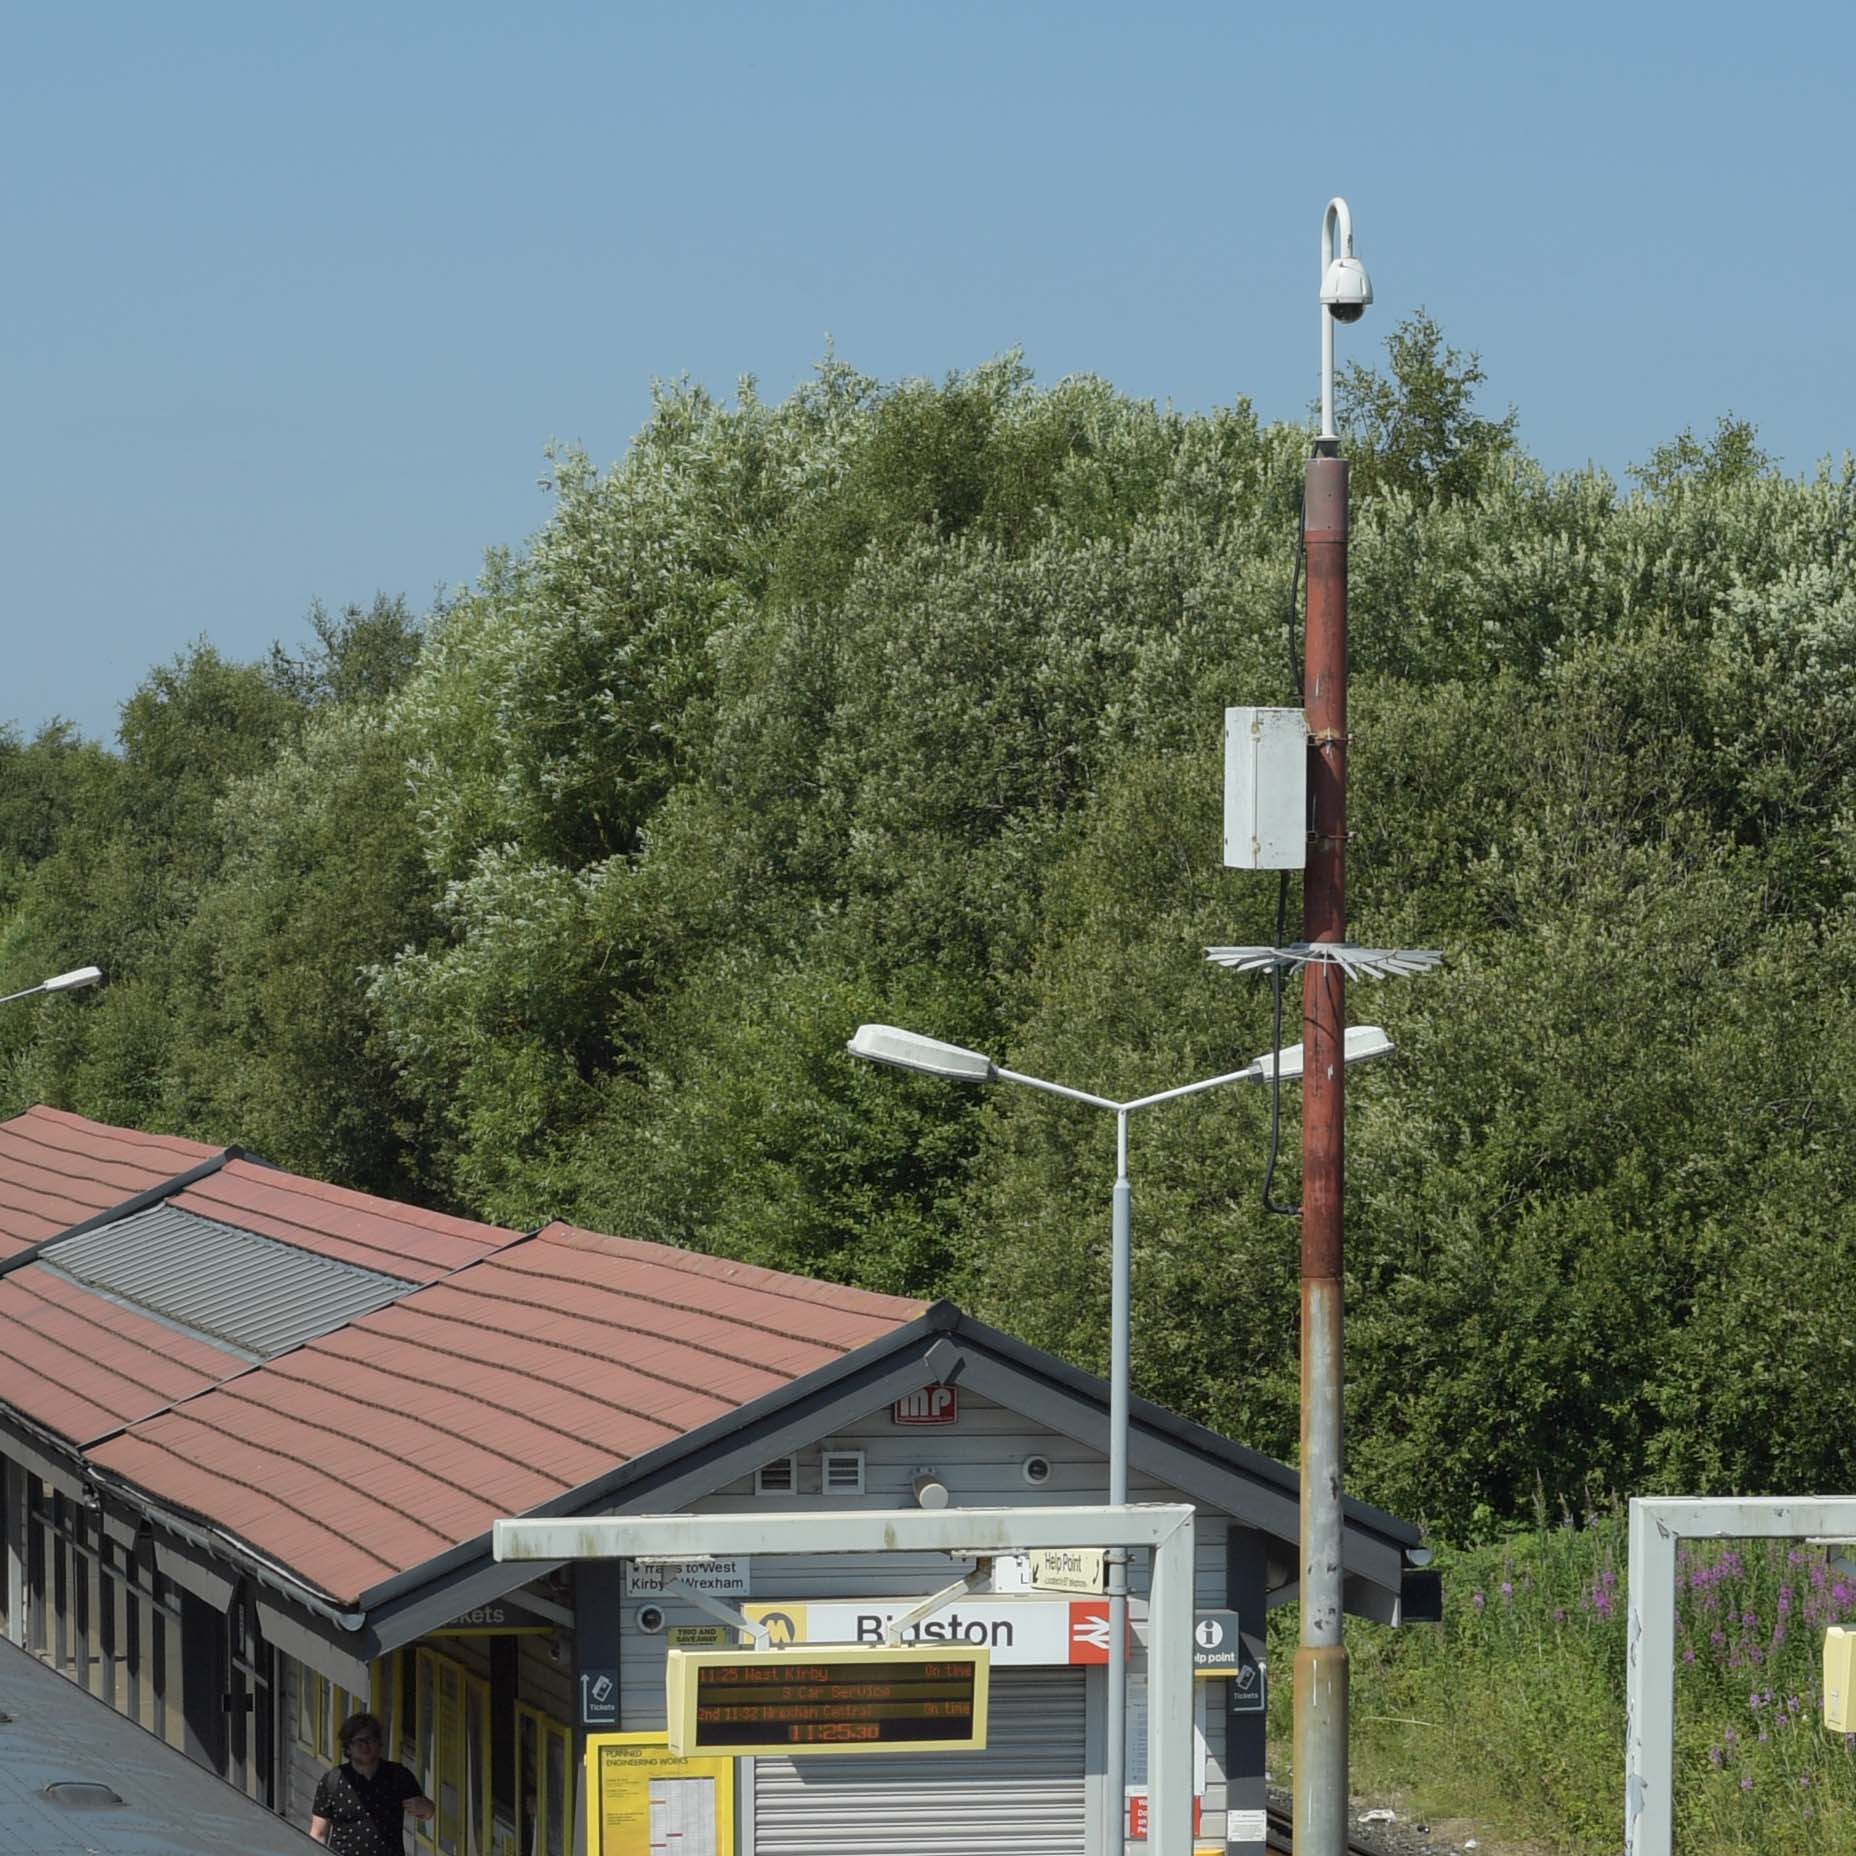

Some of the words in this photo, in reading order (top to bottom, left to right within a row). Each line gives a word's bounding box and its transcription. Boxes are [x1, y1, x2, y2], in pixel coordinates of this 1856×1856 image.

[645, 1563, 682, 1574] Tras
[686, 1562, 699, 1574] to
[702, 1561, 737, 1574] West
[1045, 1552, 1063, 1574] Help
[1063, 1553, 1082, 1573] Point
[631, 1577, 664, 1592] Kirby
[681, 1577, 744, 1590] Wrexham
[449, 1606, 505, 1624] kets
[1208, 1651, 1235, 1666] point
[745, 1666, 778, 1680] West
[785, 1667, 828, 1682] Kirby
[799, 1686, 824, 1699] Car
[832, 1684, 891, 1698] Service
[1233, 1692, 1259, 1700] Tickets
[589, 1703, 615, 1711] Tickets
[763, 1706, 817, 1720] Wrexham
